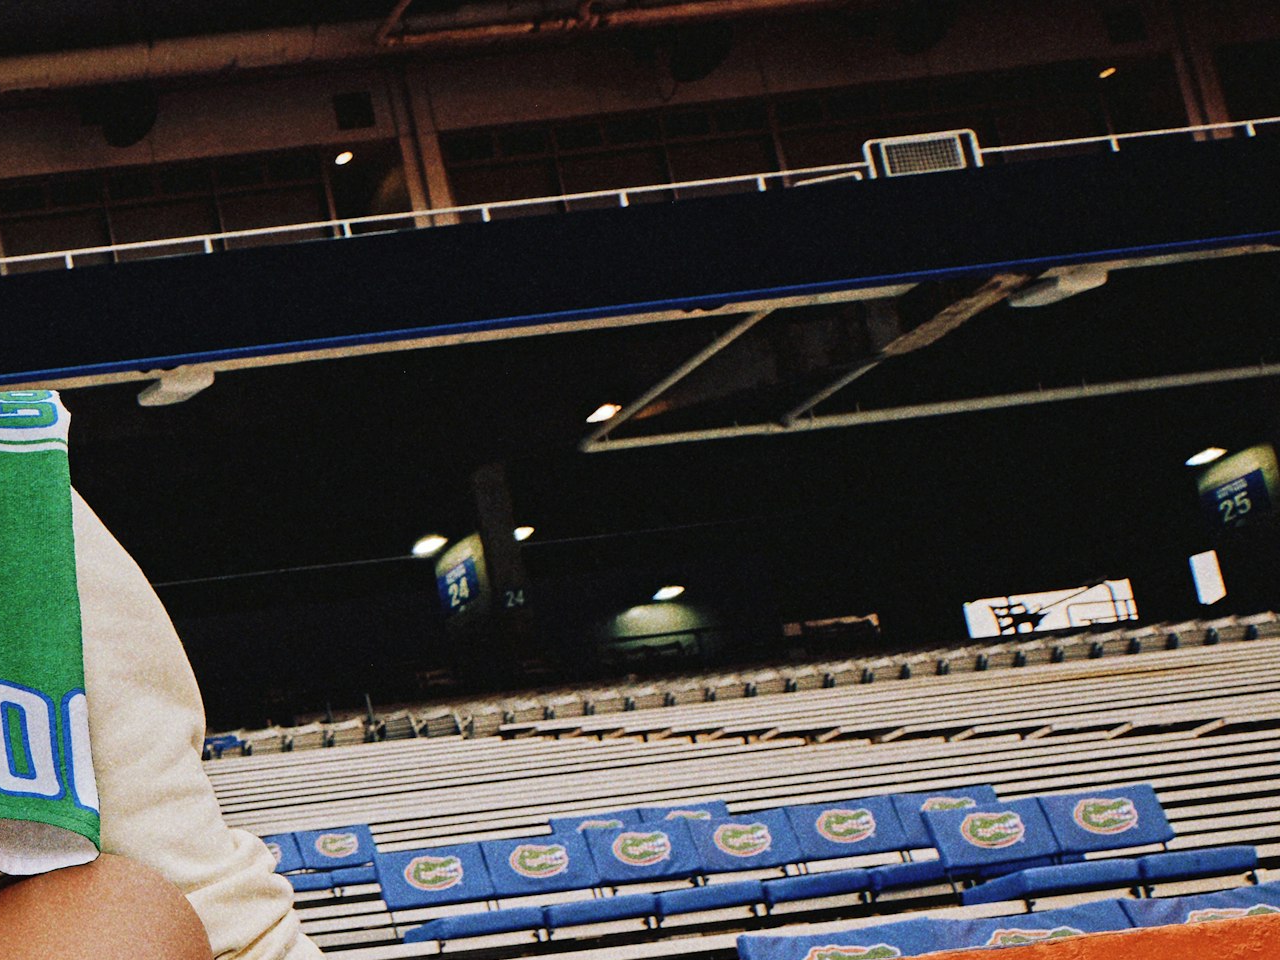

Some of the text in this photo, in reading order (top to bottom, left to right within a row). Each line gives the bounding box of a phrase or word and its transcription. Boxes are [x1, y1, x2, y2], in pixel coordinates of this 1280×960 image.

[1219, 491, 1252, 521] 25
[448, 576, 470, 608] 24
[506, 589, 525, 608] 24
